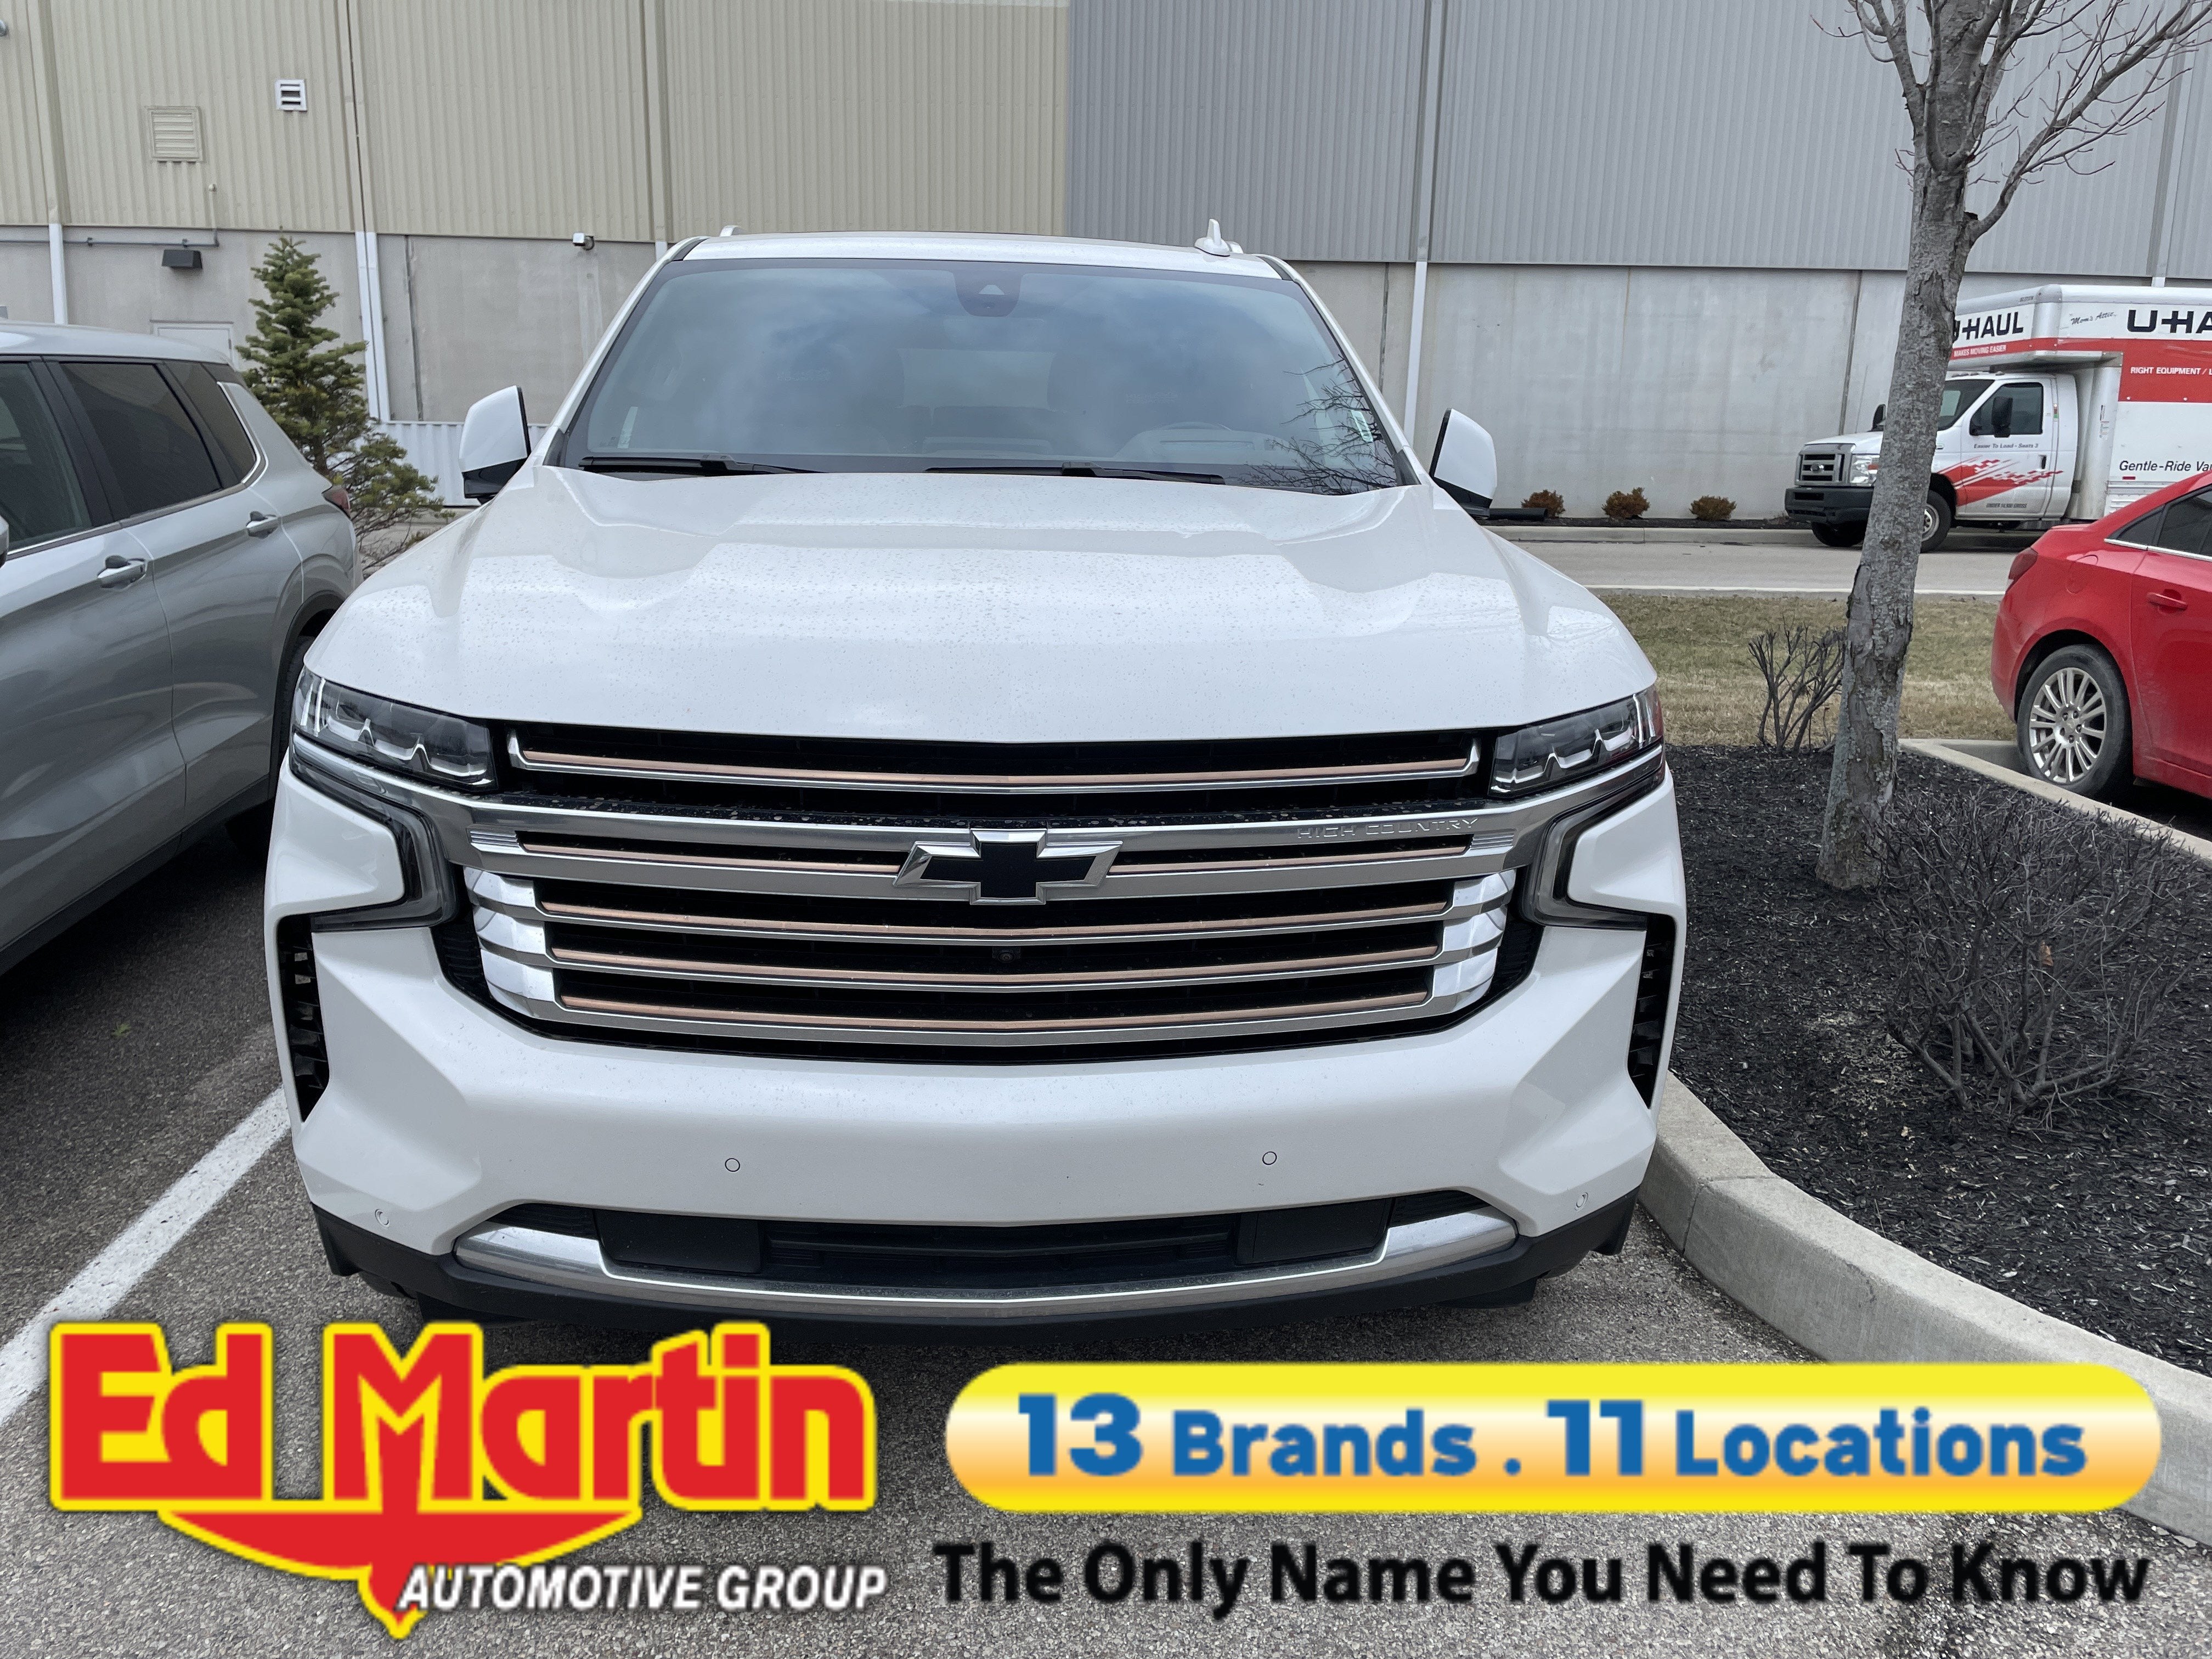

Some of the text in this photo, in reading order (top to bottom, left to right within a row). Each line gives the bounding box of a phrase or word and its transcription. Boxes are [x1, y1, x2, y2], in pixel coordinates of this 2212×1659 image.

[2119, 460, 2192, 471] Gentle-Ride
[1297, 818, 1479, 839] HIGH COUNTRY
